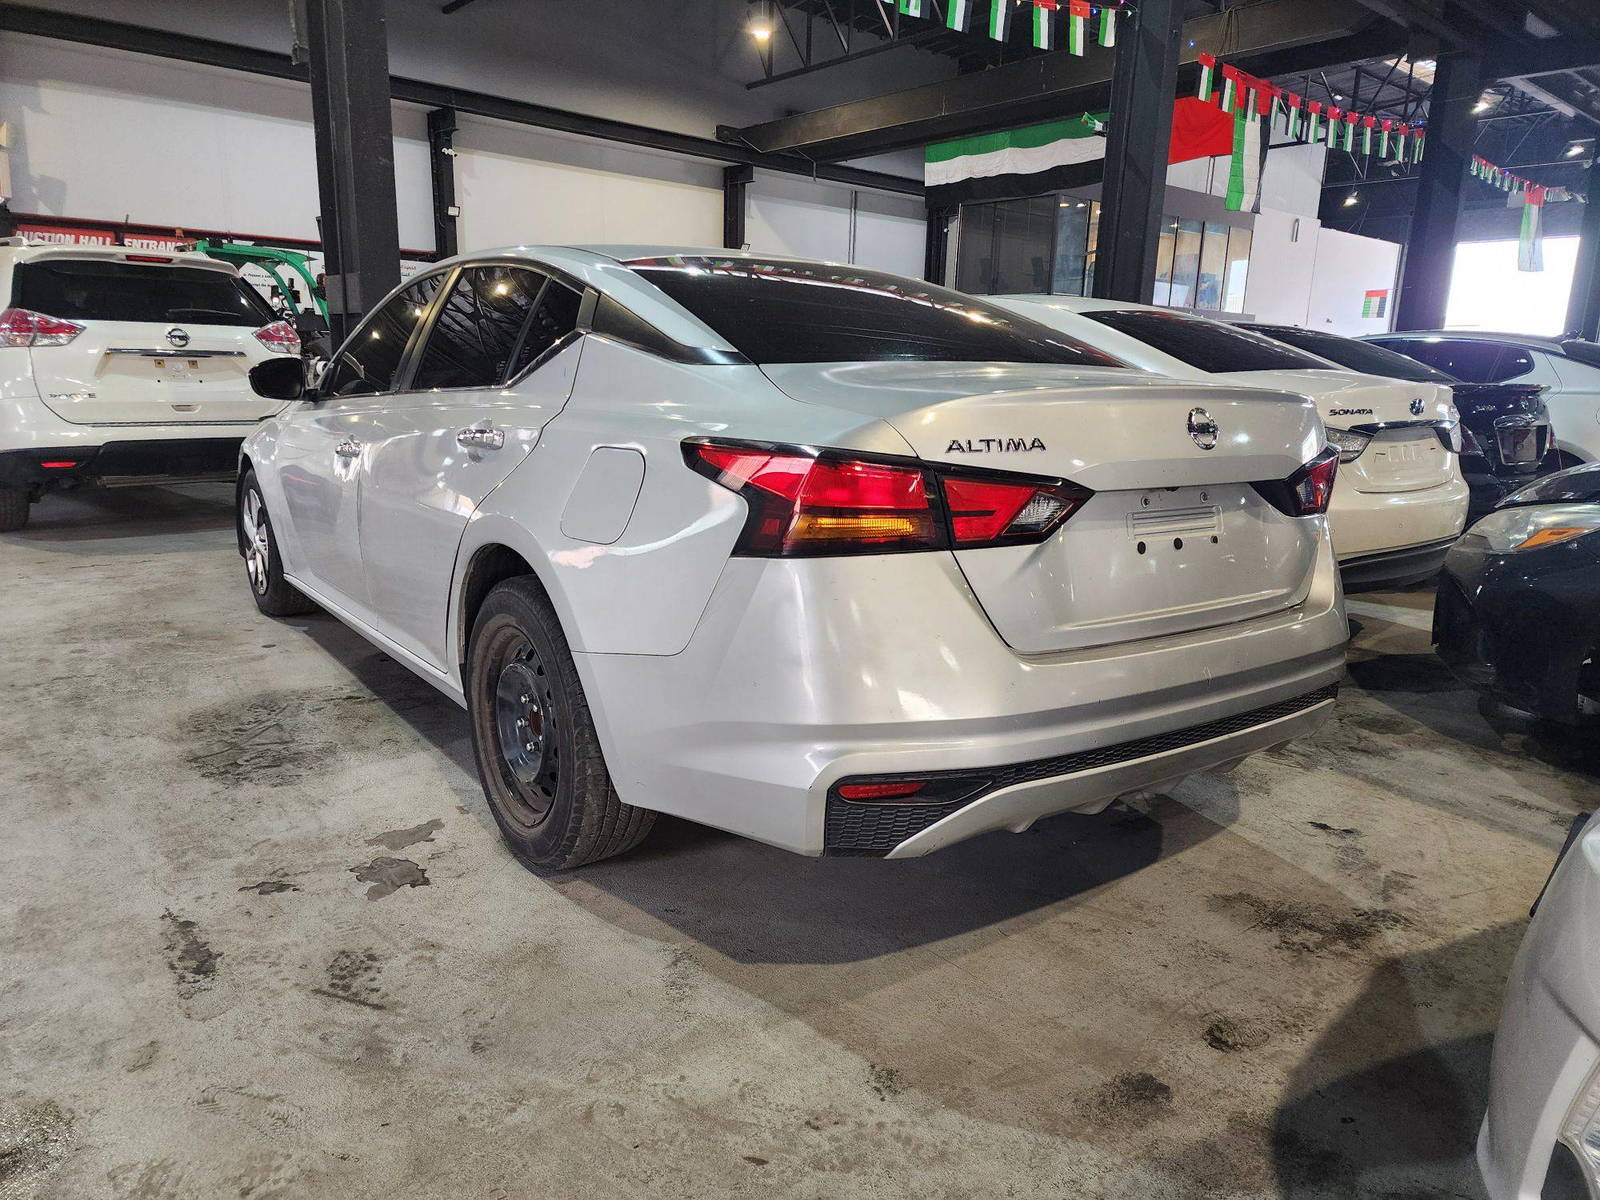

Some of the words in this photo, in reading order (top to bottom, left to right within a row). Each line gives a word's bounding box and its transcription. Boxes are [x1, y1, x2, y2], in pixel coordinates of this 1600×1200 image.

[79, 234, 112, 248] HALL
[1328, 407, 1374, 417] SONATA
[945, 437, 1047, 454] ALTIMA
